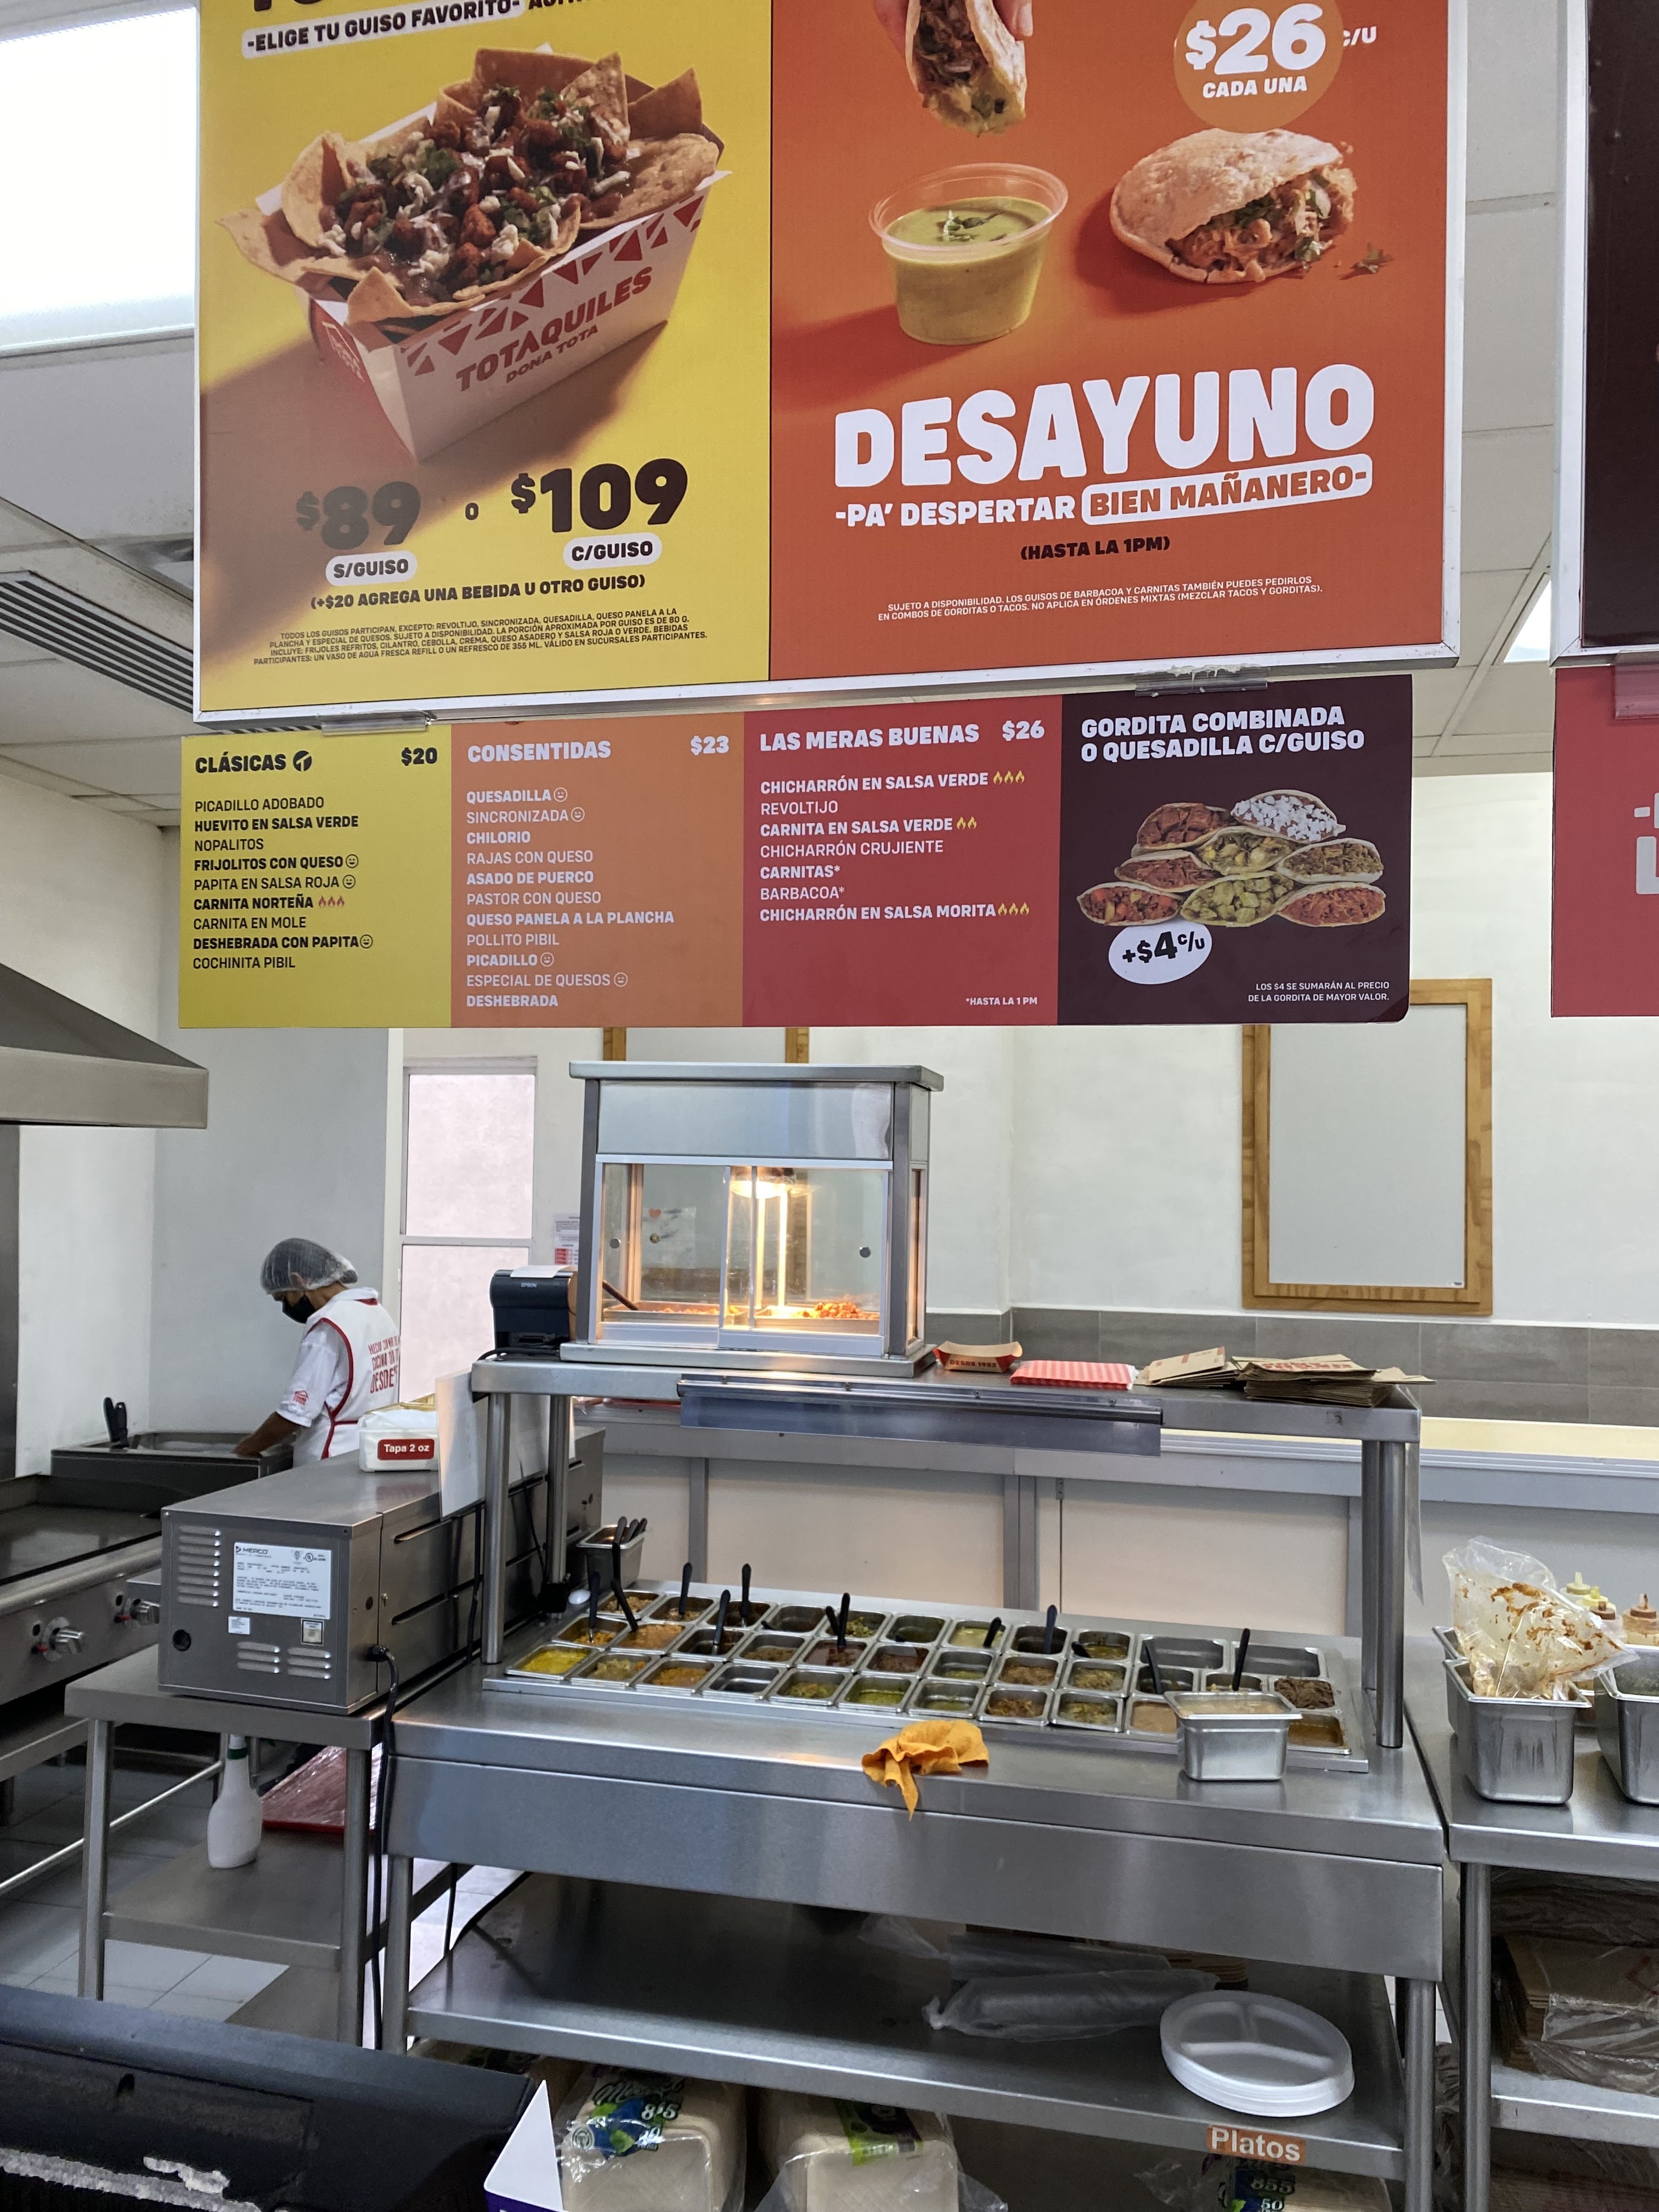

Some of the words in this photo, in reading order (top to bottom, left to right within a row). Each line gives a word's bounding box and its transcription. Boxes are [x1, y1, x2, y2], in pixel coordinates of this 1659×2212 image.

[314, 22, 339, 41] TU
[345, 13, 405, 37] GUISO
[1185, 3, 1326, 75] $26
[1203, 79, 1257, 98] CADA
[1264, 76, 1307, 94] UNA
[456, 267, 653, 392] TOTAQUILES
[556, 324, 598, 354] TOTA
[834, 364, 1374, 488] DESAYUNO
[296, 481, 421, 550] $89
[511, 458, 687, 533] $109
[901, 496, 1075, 526] DESPERTAR
[1090, 484, 1160, 516] BIEN
[571, 540, 653, 562] C/GUISO
[1020, 541, 1090, 560] (HASTA
[1095, 539, 1119, 556] LA
[1124, 536, 1170, 555] 1PM)
[333, 558, 409, 579] S/GUISO
[357, 589, 420, 607] AGREGA
[424, 586, 458, 603] UNA
[462, 582, 520, 601] BEBIDA
[524, 581, 535, 597] U
[539, 578, 583, 596] OTRO
[588, 574, 645, 594] GUISO)
[888, 602, 921, 611] SUJETO
[932, 597, 1003, 608] DISPONIBILIDAD.
[1006, 595, 1022, 603] LOS
[1025, 593, 1058, 602] GUISOS
[1074, 589, 1124, 599] BARBACOA
[1134, 585, 1180, 595] CARNITAS
[1182, 581, 1223, 592] TAMBIÉN
[1226, 579, 1262, 589] PUEDES
[1265, 577, 1311, 586] PEDIRLOS
[1082, 714, 1186, 738] GORDITA
[1193, 706, 1344, 732] COMBINADA
[760, 732, 800, 751] LAS
[806, 729, 883, 749] MERAS
[889, 725, 979, 746] BUENAS
[1002, 720, 1045, 742] $26
[468, 741, 611, 763] CONSENTIDAS
[690, 736, 730, 755] $23
[1081, 743, 1097, 762] O
[1103, 735, 1252, 761] QUESADILLA
[1259, 730, 1364, 754] C/GUISO
[195, 752, 286, 773] CLÁSICAS
[401, 747, 438, 766] $20
[761, 775, 857, 794] CHICHARRÓN
[862, 777, 881, 790] EN
[885, 775, 934, 789] SALSA
[938, 772, 988, 787] VERDE
[467, 789, 551, 803] QUESADILLA
[195, 799, 258, 812] PICADILLO
[262, 797, 324, 810] ADOBADO
[761, 800, 838, 816] REVOLTIJO
[195, 819, 248, 831] HUEVITO
[252, 819, 268, 830] EN
[272, 817, 312, 829] SALSA
[316, 816, 358, 828] VERDE
[467, 810, 568, 823] SINCRONIZADA
[760, 822, 825, 836] CARNITA
[828, 822, 847, 834] EN
[851, 820, 899, 834] SALSA
[903, 818, 952, 832] VERDE
[195, 839, 263, 851] NOPALITOS
[467, 832, 530, 844] CHILORIO
[760, 840, 855, 858] CHICHARRÓN
[860, 840, 943, 855] CRUJIENTE
[195, 859, 266, 871] FRIJOLITOS
[270, 857, 296, 869] CON
[300, 856, 342, 868] QUESO
[467, 852, 511, 864] RAJAS
[515, 851, 543, 864] CON
[547, 851, 592, 863] QUESO
[194, 879, 238, 890] PAPITA
[241, 878, 257, 889] EN
[261, 877, 301, 889] SALSA
[306, 877, 339, 888] ROJA
[466, 872, 513, 884] ASADO
[517, 872, 534, 884] DE
[538, 871, 593, 884] PUERCO
[194, 899, 249, 910] CARNITA
[252, 894, 313, 909] NORTEÑA
[467, 893, 519, 905] PASTOR
[523, 893, 551, 904] CON
[555, 892, 601, 904] QUESO
[467, 913, 512, 926] QUESO
[516, 913, 569, 925] PANELA
[573, 912, 582, 924] A
[586, 912, 603, 924] LA
[607, 911, 674, 924] PLANCHA
[760, 905, 856, 922] CHICHARRÓN
[861, 906, 879, 919] EN
[884, 905, 932, 919] SALSA
[937, 904, 995, 918] MORITA
[194, 918, 247, 929] CARNITA
[251, 918, 267, 929] EN
[272, 917, 306, 928] MOLE
[194, 937, 278, 949] DESHEBRADA
[281, 936, 308, 948] CON
[312, 936, 359, 947] PAPITA
[467, 934, 521, 946] POLLITO
[526, 933, 559, 945] PIBIL
[193, 957, 260, 969] COCHINITA
[264, 957, 295, 968] PIBIL
[467, 954, 537, 966] PICADILLO
[467, 975, 531, 986] ESPECIAL
[535, 975, 551, 986] DE
[556, 974, 610, 986] QUESOS
[1256, 982, 1272, 990] LOS
[1274, 982, 1284, 990] $4
[1286, 982, 1296, 990] SE
[1299, 981, 1342, 990] SUMARÁN
[1345, 981, 1355, 990] AL
[1358, 981, 1389, 990] PRECIO
[467, 995, 558, 1007] DESHEBRADA
[1248, 994, 1259, 1002] DE
[1261, 994, 1272, 1002] LA
[1313, 994, 1324, 1002] DE
[1326, 994, 1356, 1002] MAYOR
[1358, 993, 1389, 1001] VALOR.
[383, 1444, 407, 1454] Tapa
[409, 1443, 415, 1452] 2
[1212, 2127, 1300, 2162] Platos
[1261, 2198, 1284, 2210] 50
